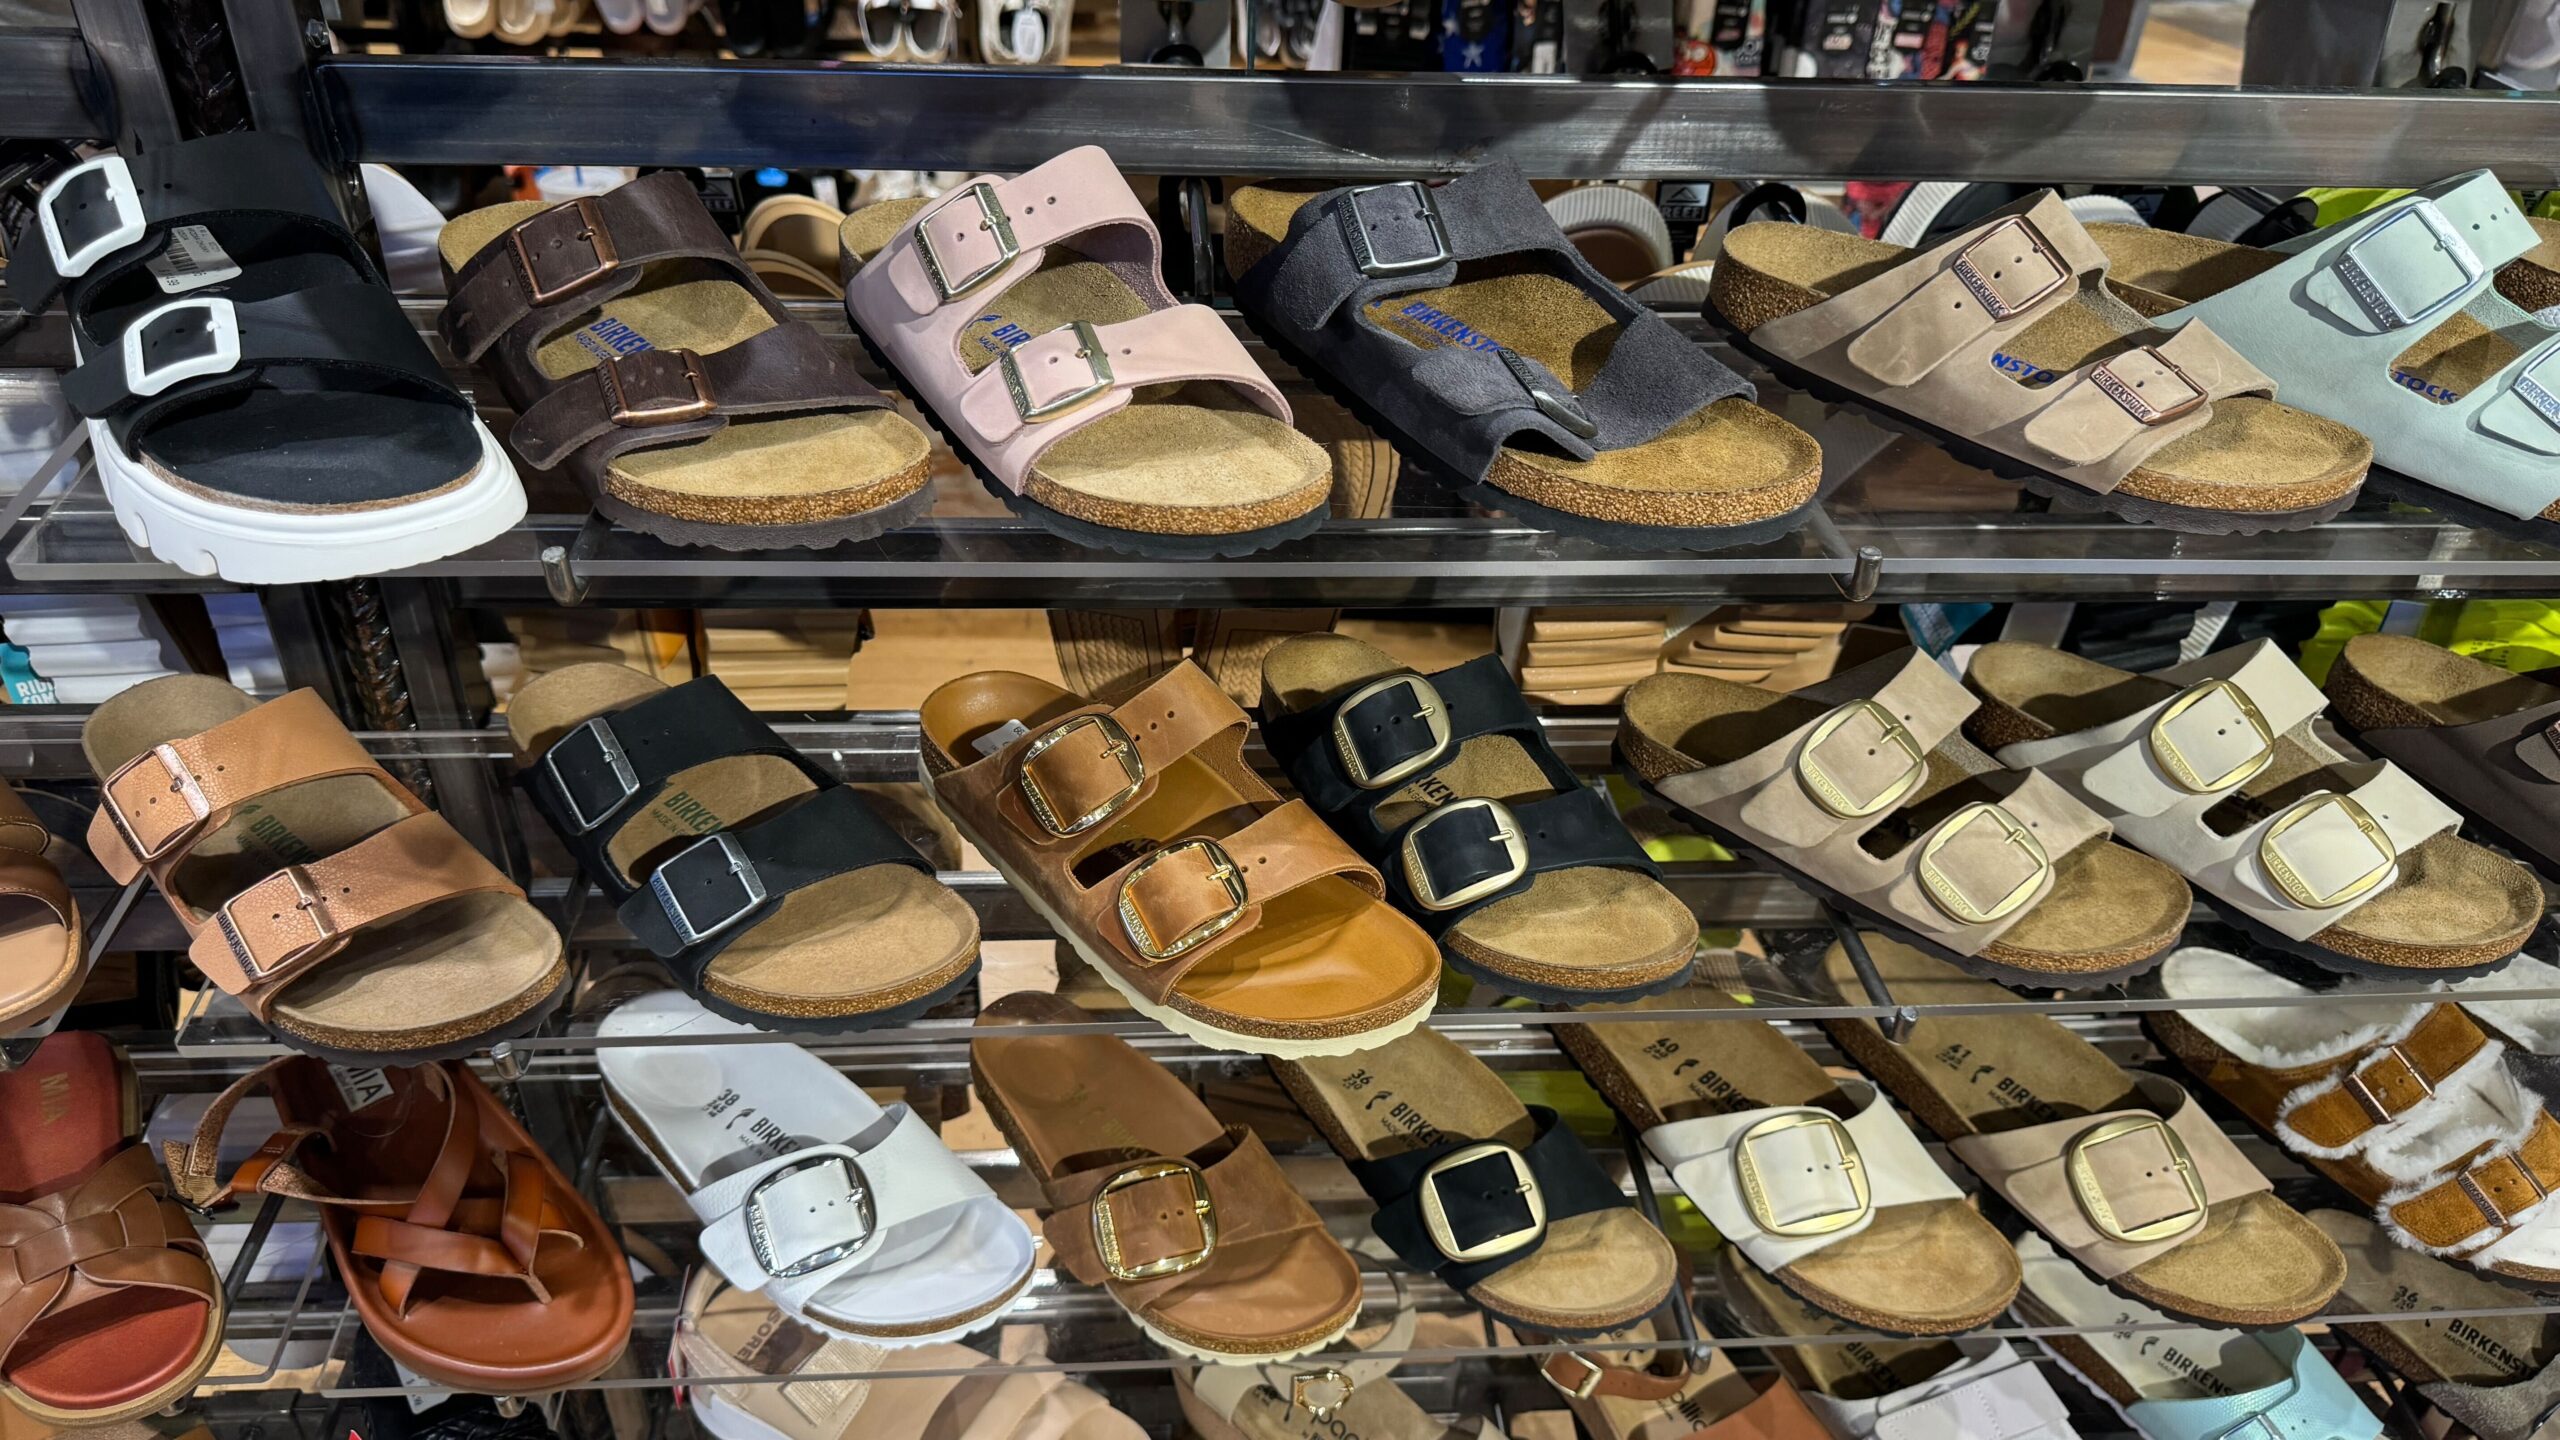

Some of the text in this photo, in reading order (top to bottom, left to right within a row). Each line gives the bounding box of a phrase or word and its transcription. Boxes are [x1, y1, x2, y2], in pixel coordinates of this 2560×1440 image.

[1662, 207, 1700, 218] REEF
[1955, 260, 2008, 318] BIRKENSTOCK
[2339, 260, 2397, 327] BIRKENSTOCK
[1991, 352, 2055, 384] NSTO
[2093, 369, 2151, 419] BIRKENSTOCK
[1804, 763, 1849, 811] BIRKENSTOCK
[2265, 851, 2311, 901] BIRKENSTOCK
[1925, 869, 1972, 917] BIRKENSTOCK
[1656, 1037, 1680, 1053] 40
[1949, 1044, 1972, 1059] 41
[1351, 1068, 1374, 1085] 36
[718, 1088, 741, 1106] 38
[2444, 1332, 2466, 1350] MADE
